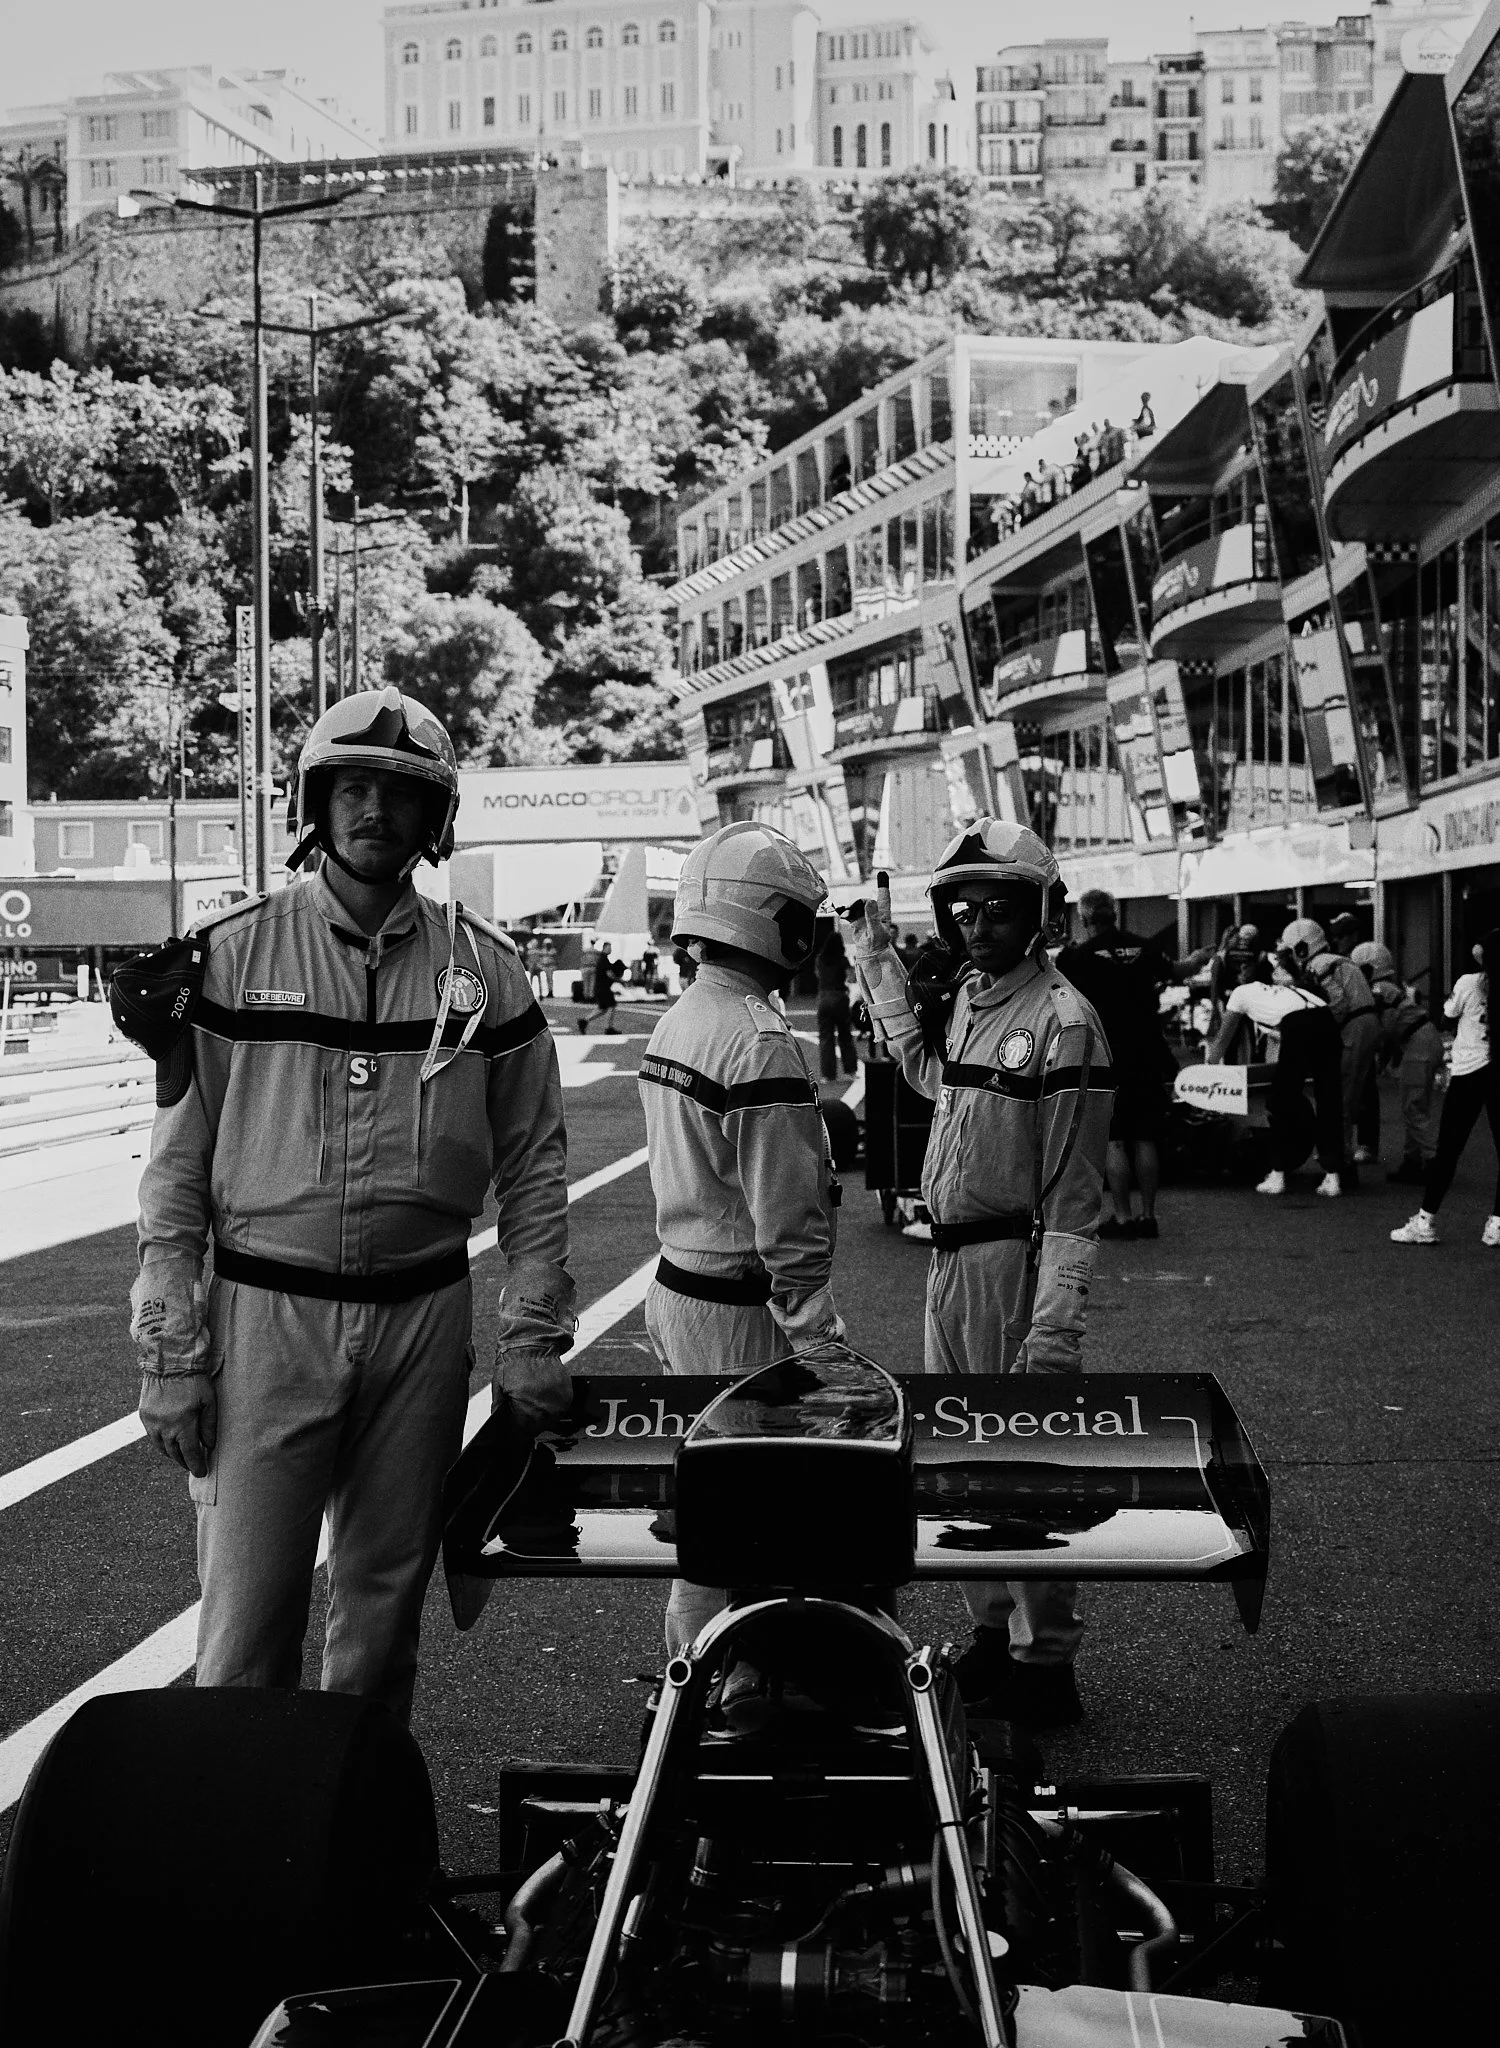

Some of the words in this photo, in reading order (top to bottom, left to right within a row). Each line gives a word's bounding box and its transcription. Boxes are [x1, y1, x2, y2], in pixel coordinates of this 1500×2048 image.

[0, 923, 32, 938] LO
[171, 987, 190, 1019] 2026
[932, 1396, 1149, 1443] Special
